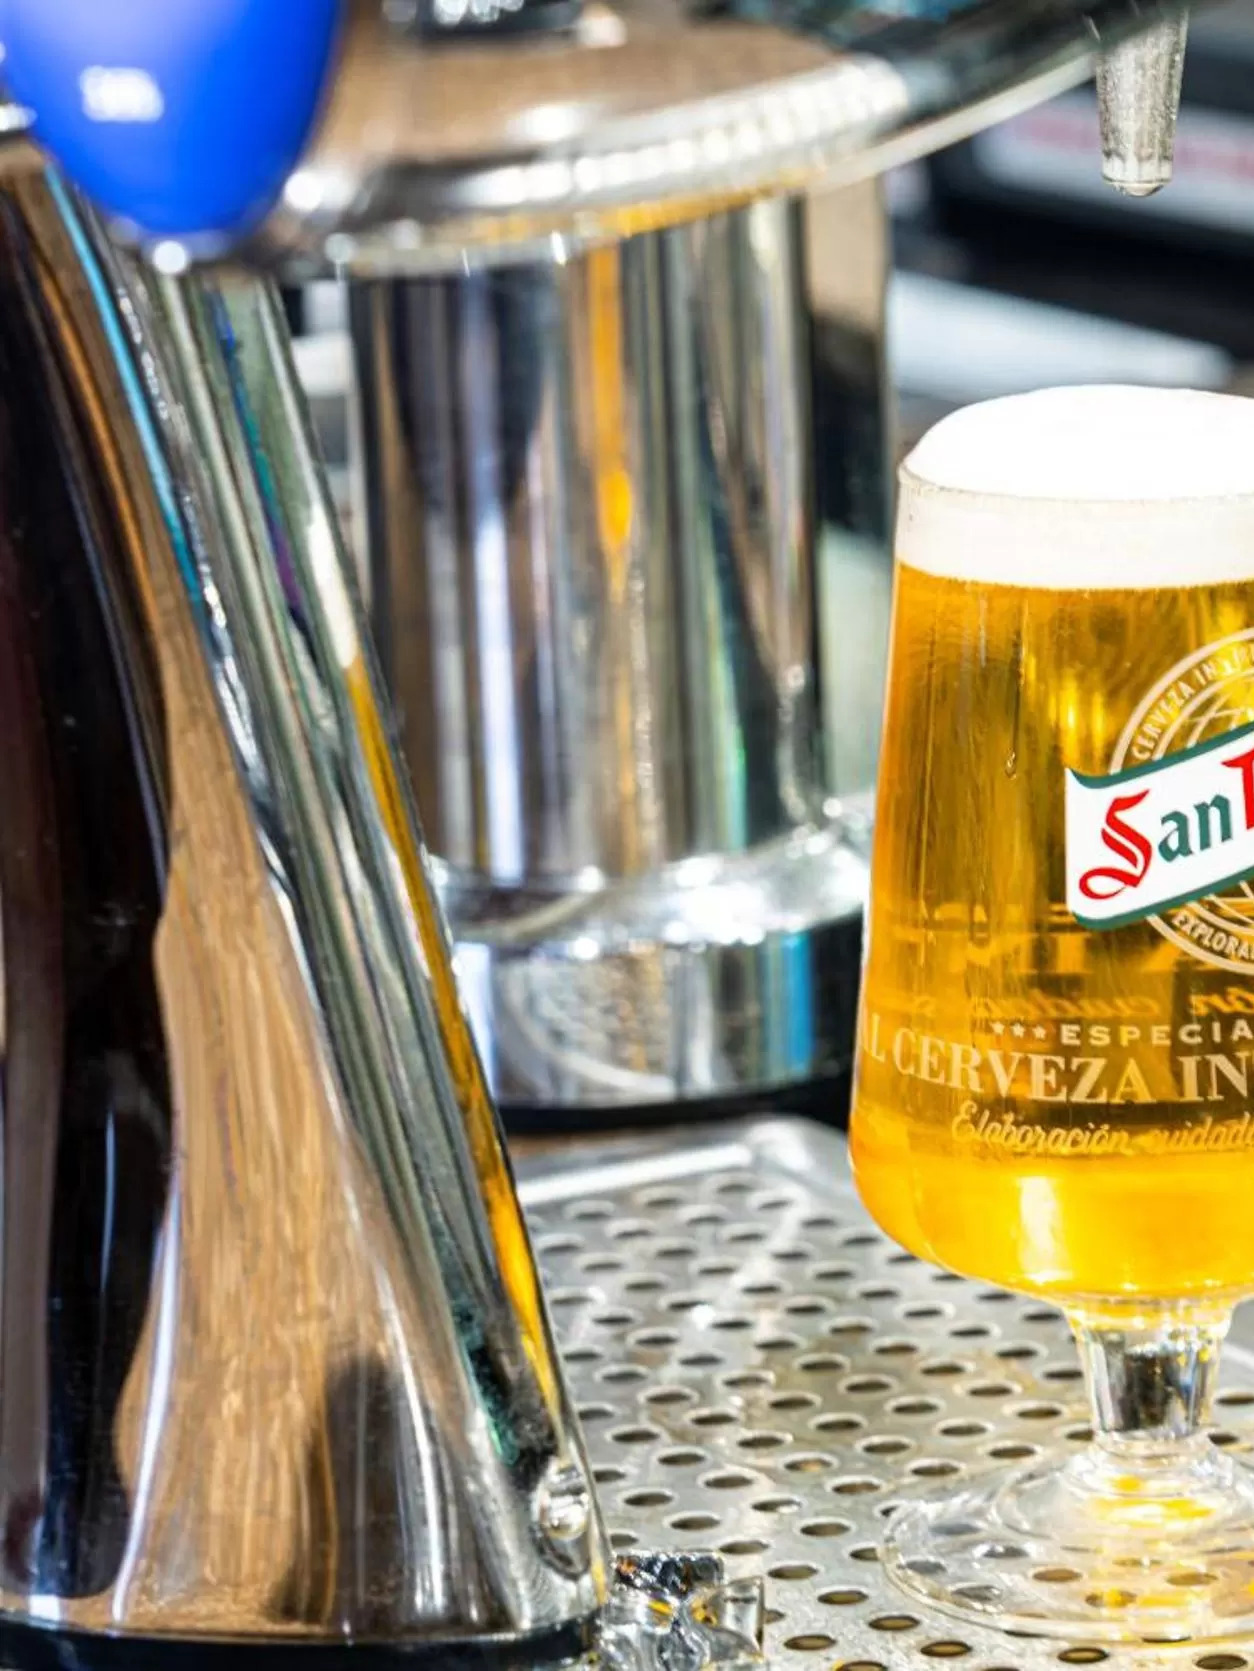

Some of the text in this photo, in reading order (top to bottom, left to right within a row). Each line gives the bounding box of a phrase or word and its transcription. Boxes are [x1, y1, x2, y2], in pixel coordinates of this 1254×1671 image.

[1131, 680, 1195, 761] CERVEZA
[1079, 788, 1233, 900] San
[892, 1027, 1158, 1105] CERVEZA
[951, 1099, 1136, 1155] Elaboración
